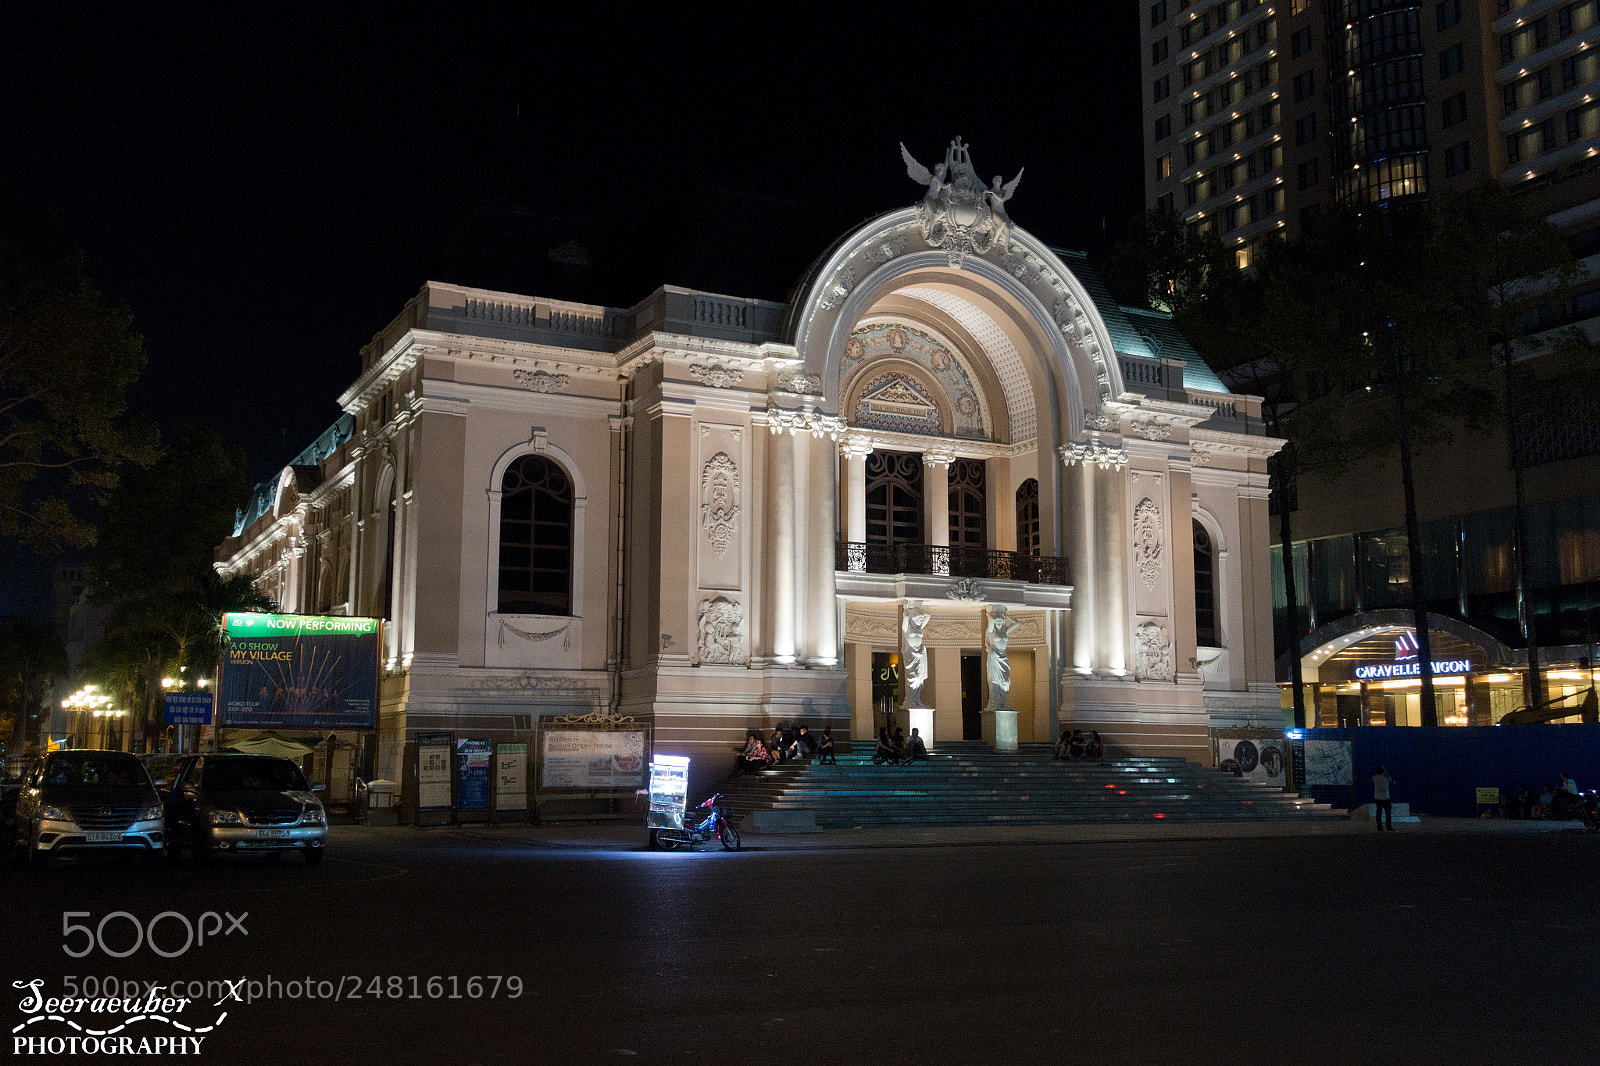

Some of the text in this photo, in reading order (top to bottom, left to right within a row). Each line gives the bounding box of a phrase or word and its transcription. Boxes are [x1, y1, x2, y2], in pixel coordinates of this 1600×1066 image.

[267, 619, 297, 629] NOW
[299, 620, 371, 632] PERFORMING
[248, 643, 279, 651] SHOW
[230, 650, 293, 661] MY VILLAGE
[1355, 660, 1470, 678] CARAVELLE AIGON
